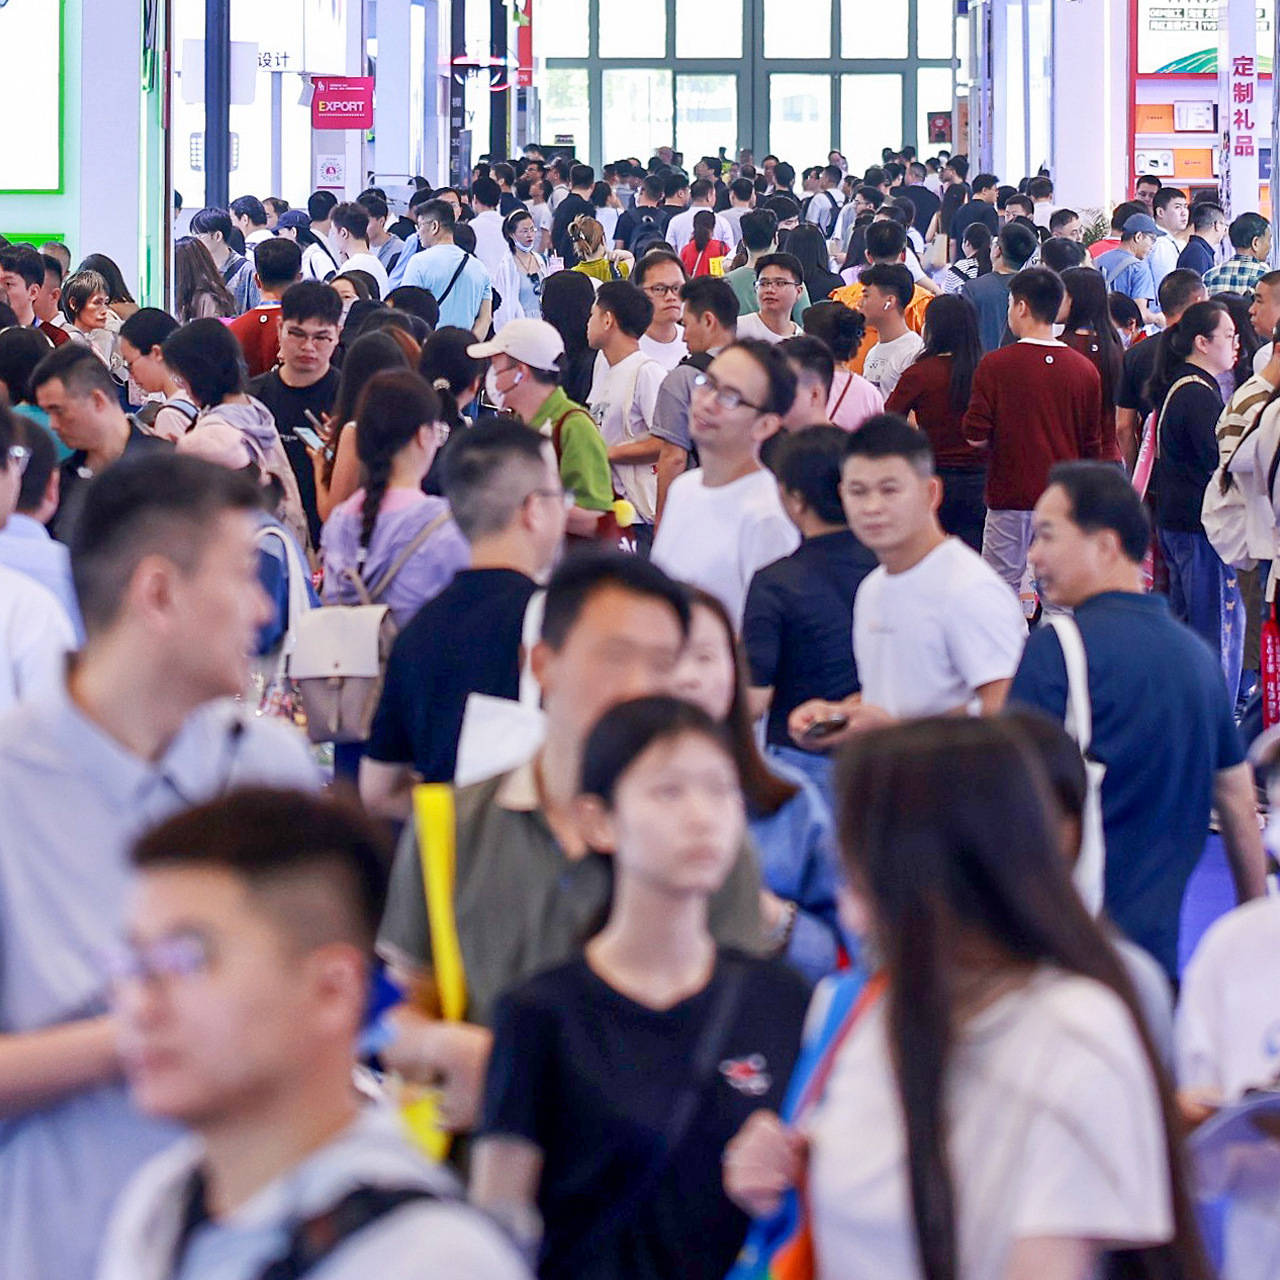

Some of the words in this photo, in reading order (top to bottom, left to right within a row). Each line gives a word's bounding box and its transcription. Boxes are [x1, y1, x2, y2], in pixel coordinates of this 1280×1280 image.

[258, 51, 290, 68] 设计
[318, 100, 366, 112] EXPORT
[1232, 55, 1256, 157] 定制礼品
